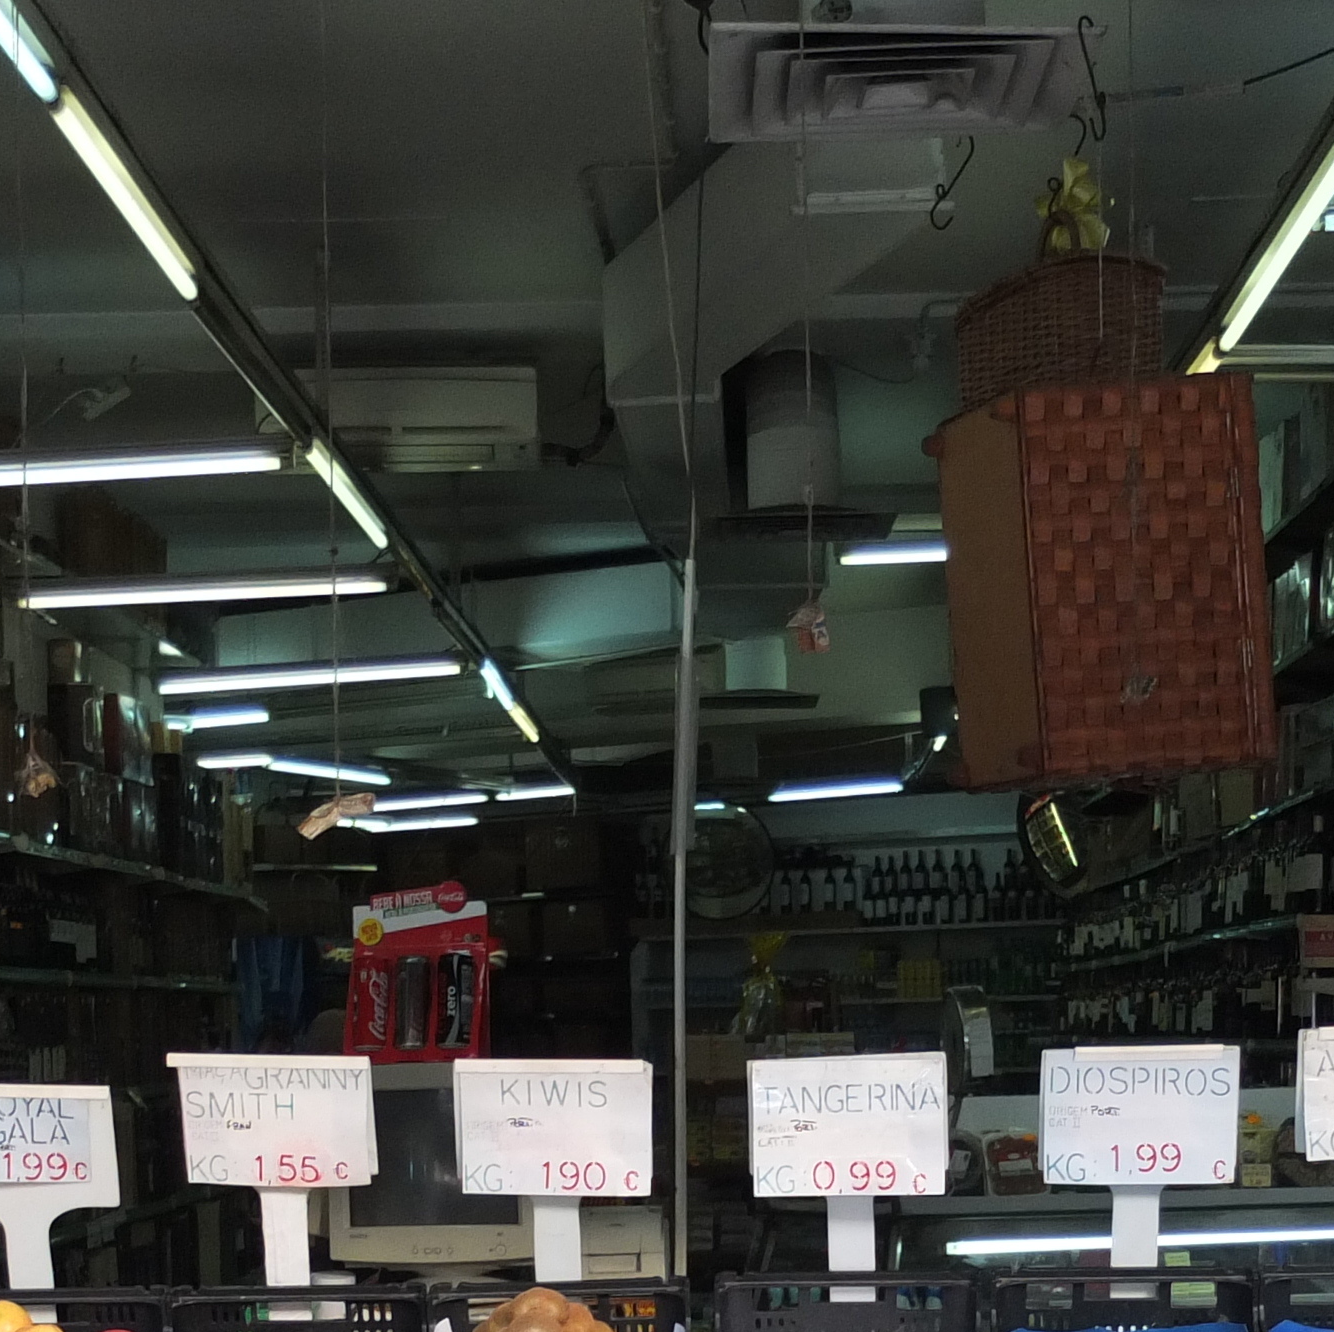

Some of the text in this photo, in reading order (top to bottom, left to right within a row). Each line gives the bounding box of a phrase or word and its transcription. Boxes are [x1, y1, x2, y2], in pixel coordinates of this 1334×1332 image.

[447, 985, 456, 1017] zero
[244, 1068, 364, 1090] GRANNY
[500, 1079, 608, 1108] KIWIS
[1049, 1066, 1231, 1097] DIOSPIROS
[186, 1091, 295, 1120] SMITH
[758, 1083, 941, 1115] TANGERINA
[2, 1152, 69, 1182] 1,99
[254, 1153, 322, 1185] 1,55
[1110, 1143, 1182, 1176] 1,99
[542, 1161, 607, 1193] 1,90
[812, 1160, 896, 1194] 0,99
